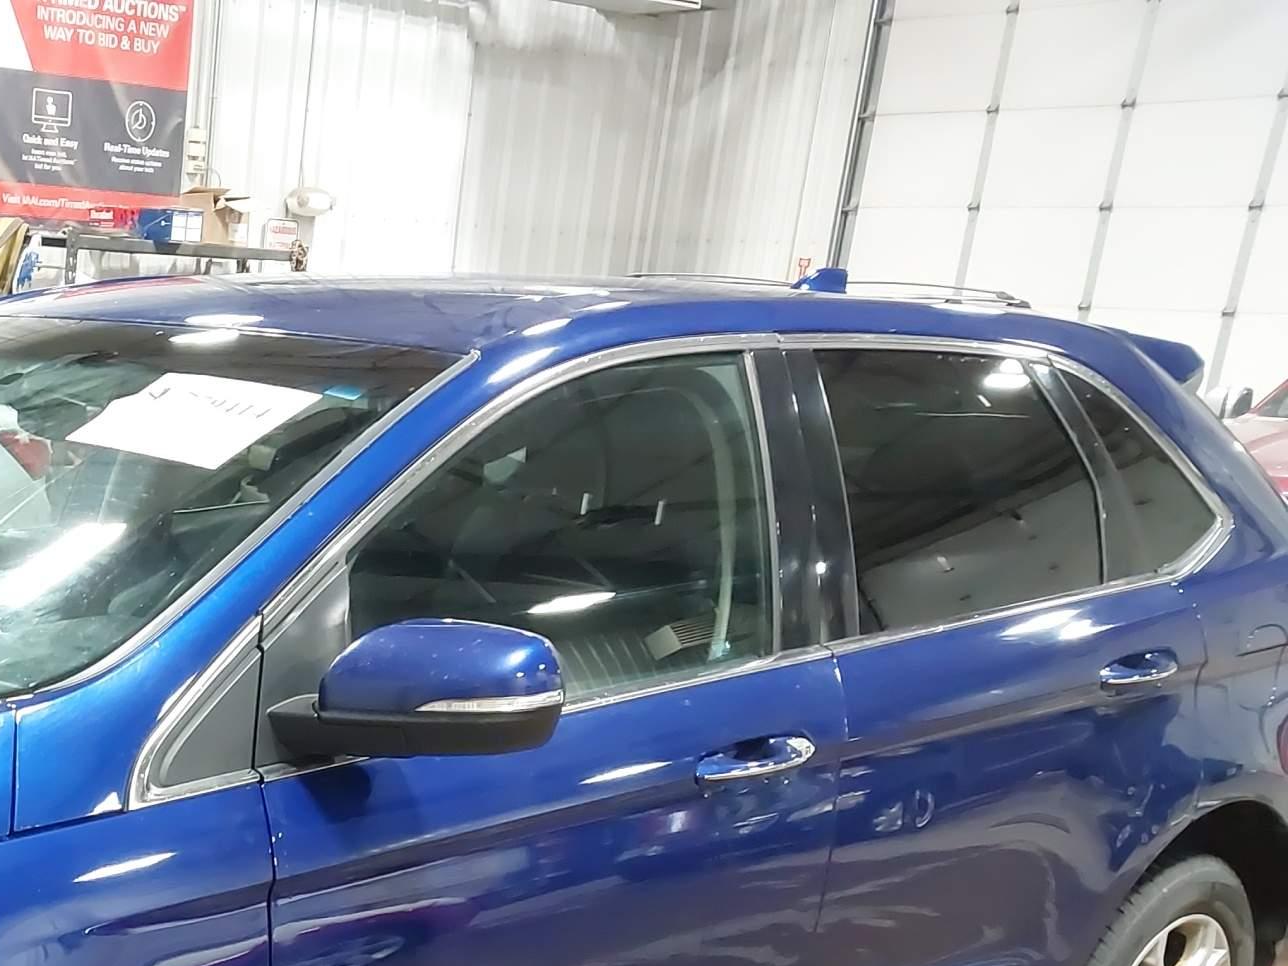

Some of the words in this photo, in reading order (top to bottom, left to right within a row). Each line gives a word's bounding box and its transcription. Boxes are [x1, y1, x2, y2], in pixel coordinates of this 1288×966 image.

[36, 5, 125, 32] INTRODUCING
[127, 19, 137, 33] A
[140, 20, 169, 39] NEW
[43, 24, 74, 42] WAY
[77, 29, 95, 45] TO
[98, 32, 118, 49] BID
[120, 35, 131, 50] &
[134, 37, 161, 54] BUY
[2, 193, 20, 204] Visit
